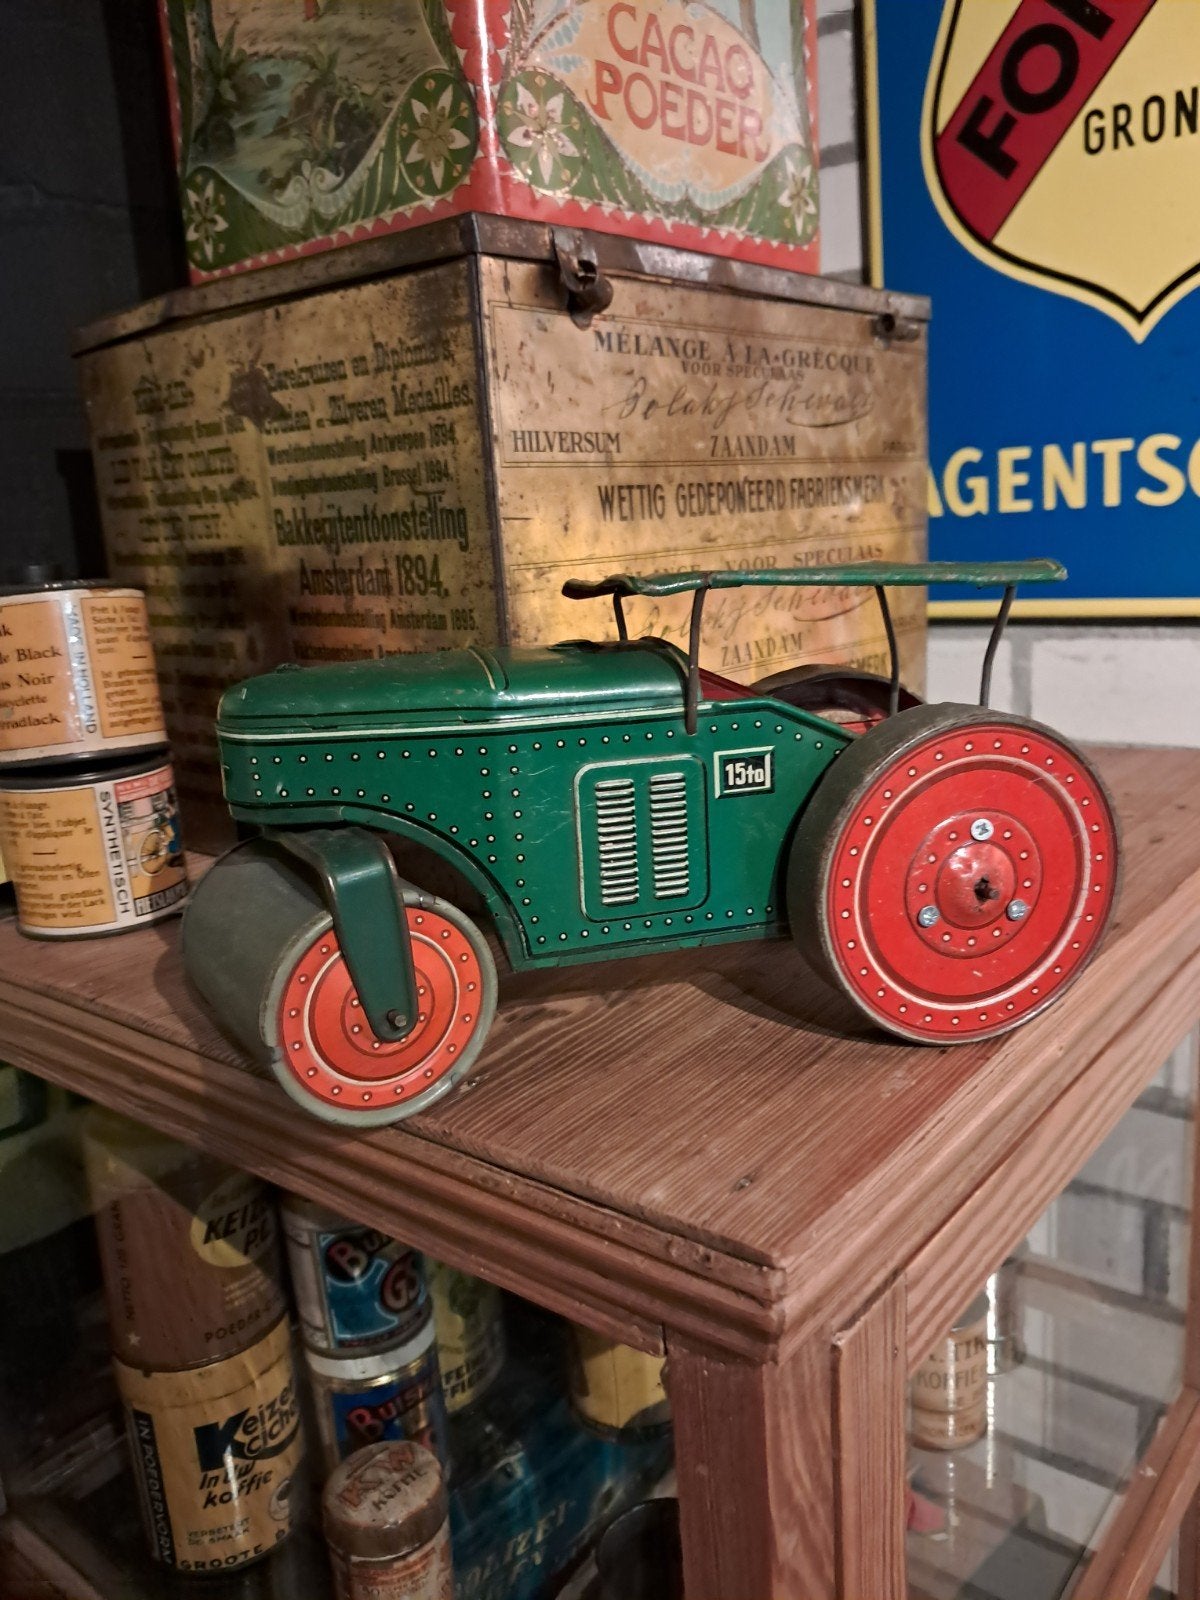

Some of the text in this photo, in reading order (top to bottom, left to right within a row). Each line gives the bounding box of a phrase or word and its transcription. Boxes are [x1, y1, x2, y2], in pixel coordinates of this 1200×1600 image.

[607, 2, 754, 100] CACAO
[585, 59, 770, 163] POEDER
[957, 0, 1115, 180] FO
[1084, 86, 1199, 155] GRON
[512, 430, 797, 458] HILVERSUM ZAANDAM
[598, 484, 665, 521] WETTIG
[675, 478, 785, 518] GEDEPONEERD
[16, 645, 62, 663] Black
[18, 673, 54, 688] Noir
[100, 791, 130, 914] SYNTHETISCH
